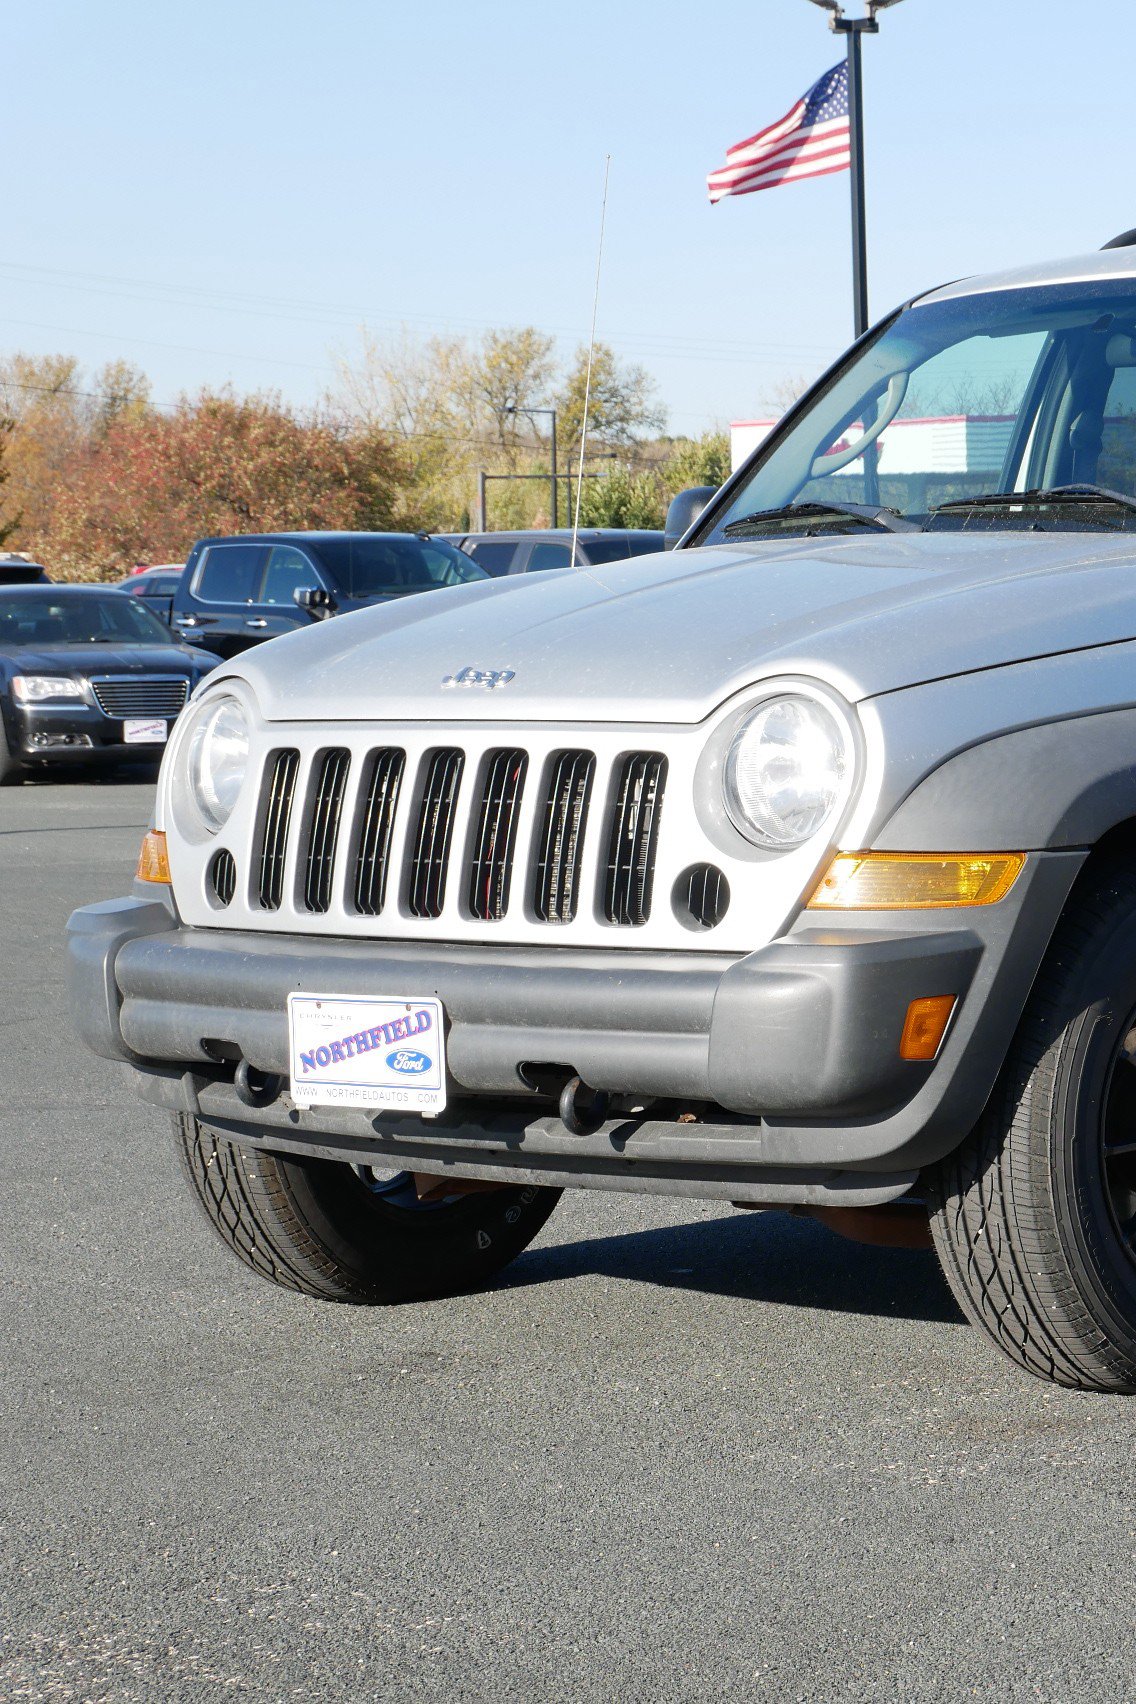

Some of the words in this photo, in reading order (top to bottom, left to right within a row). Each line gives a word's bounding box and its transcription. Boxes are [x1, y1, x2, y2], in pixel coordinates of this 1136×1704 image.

[441, 666, 516, 689] Jeep
[300, 1009, 433, 1074] NORTHFIELD
[393, 1051, 424, 1071] Ford
